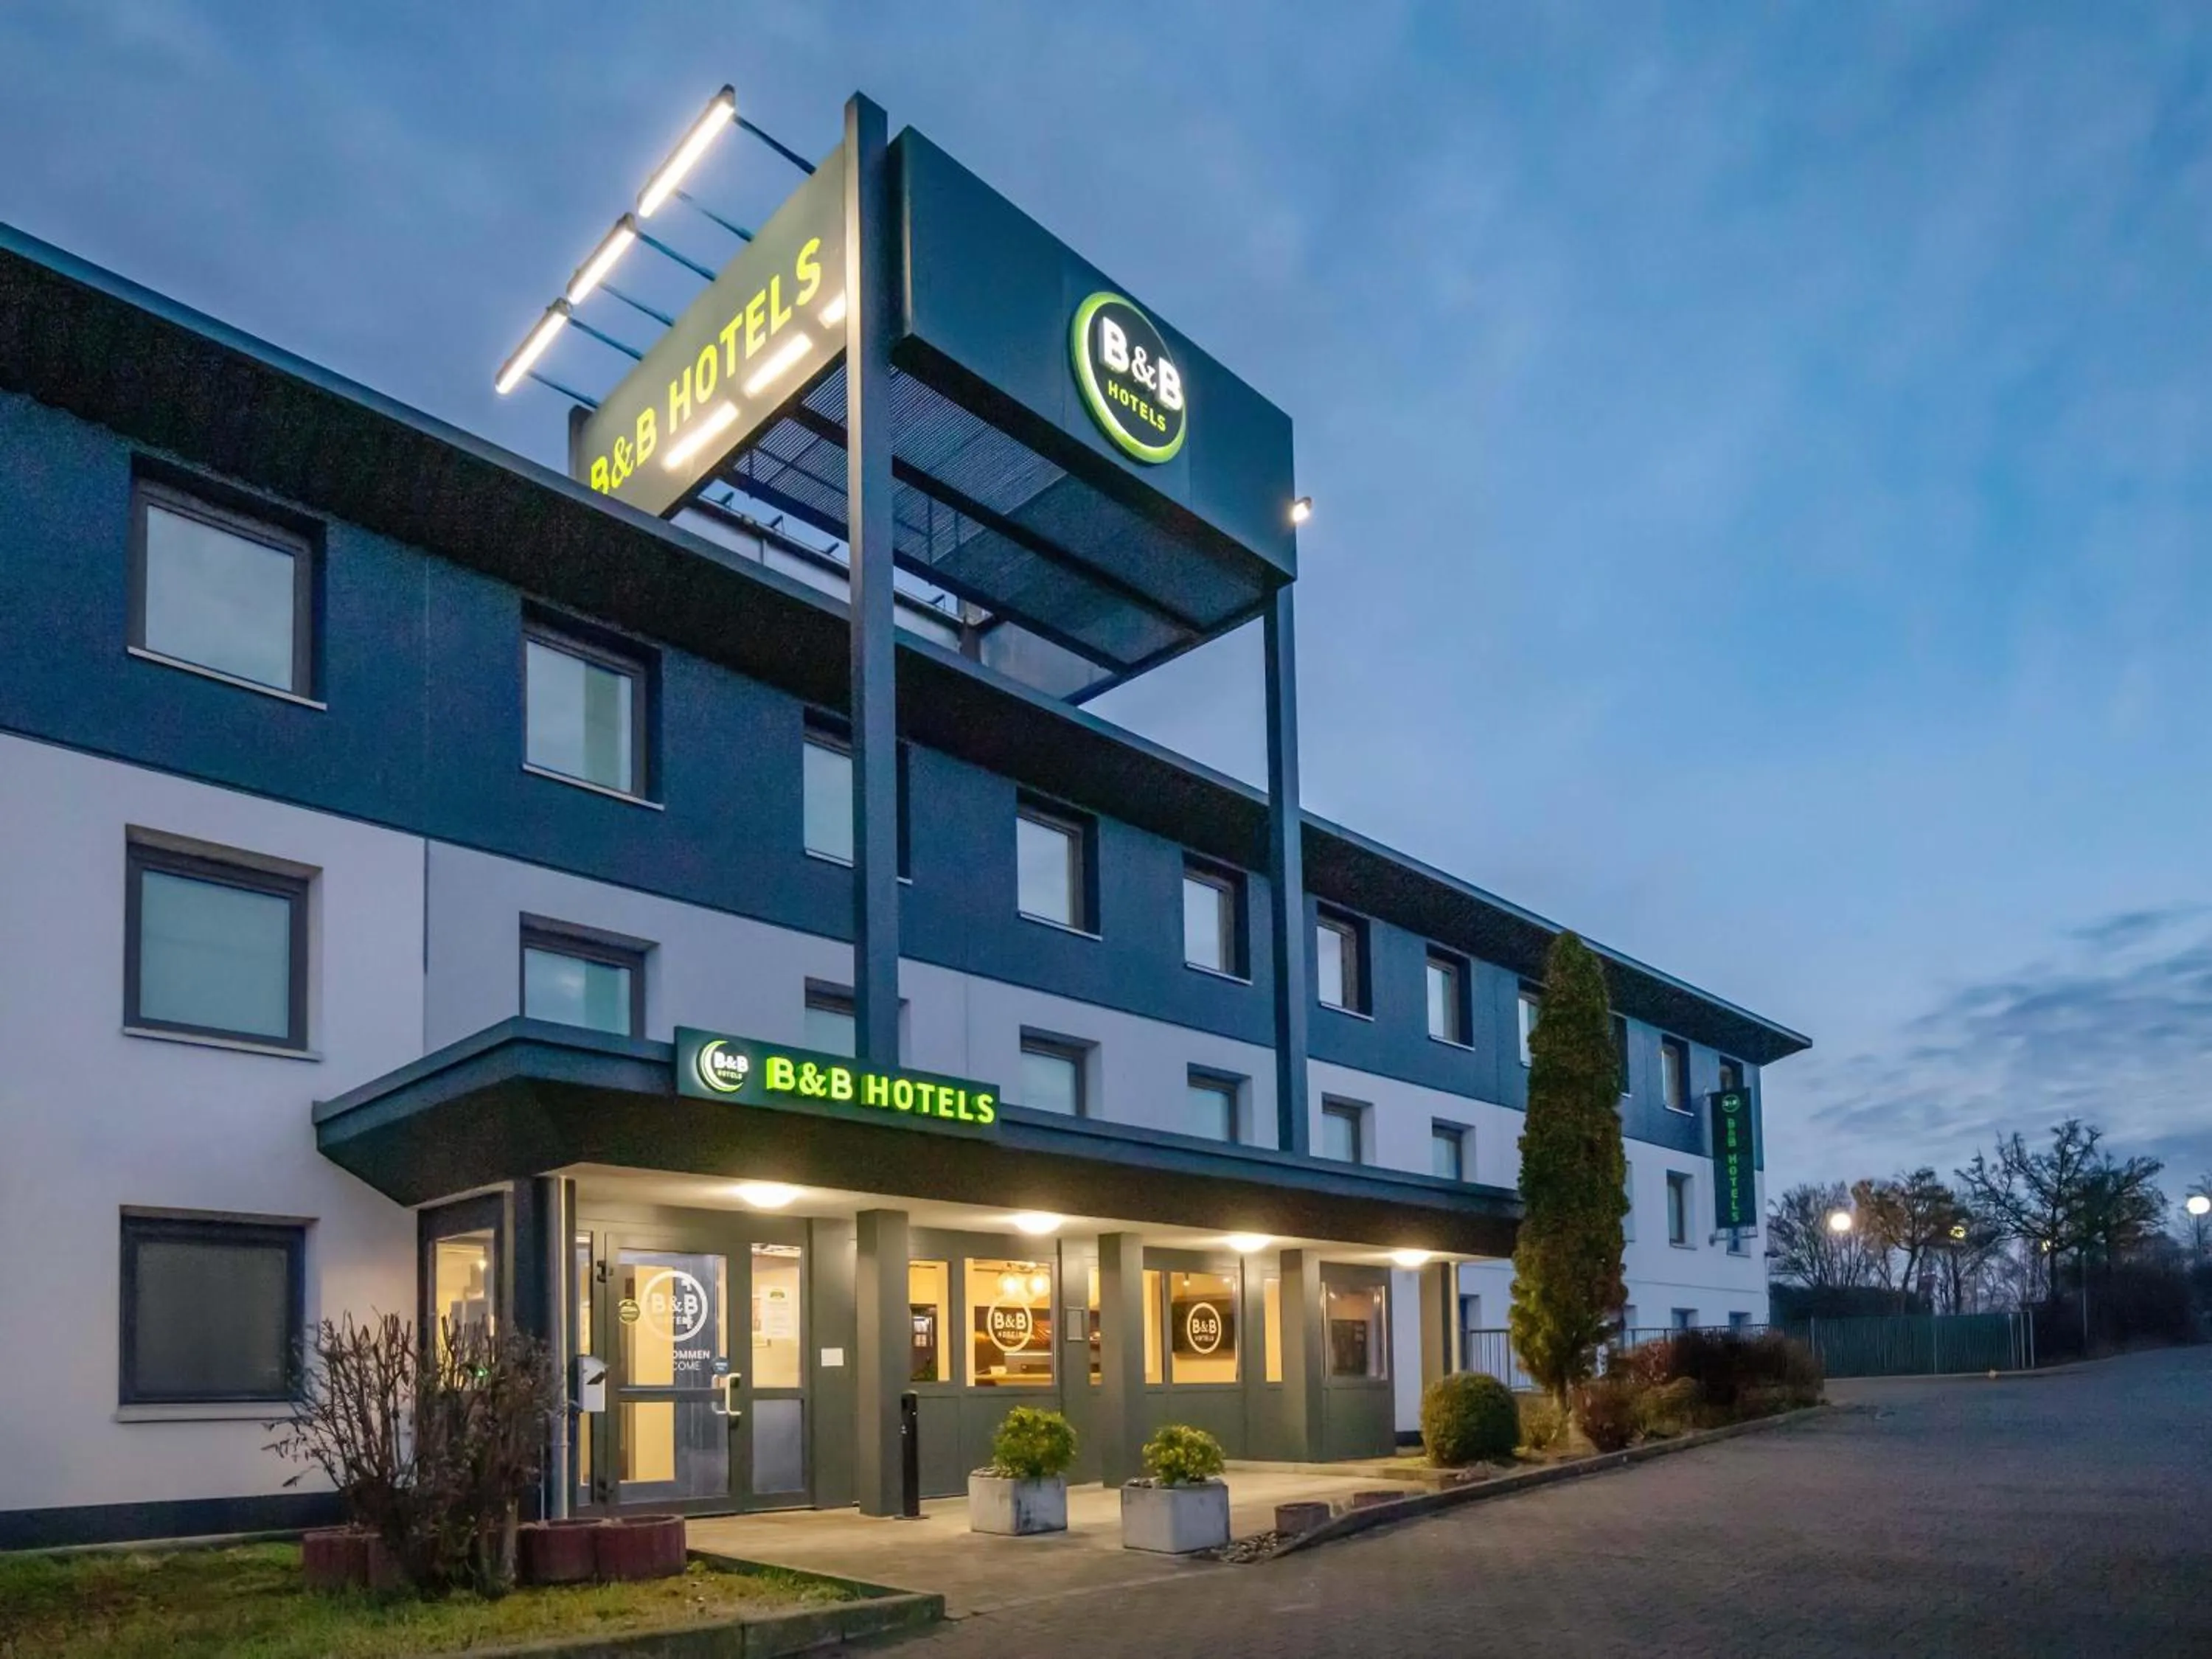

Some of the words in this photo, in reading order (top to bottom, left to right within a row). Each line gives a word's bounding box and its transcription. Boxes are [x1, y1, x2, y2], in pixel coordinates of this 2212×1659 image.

[591, 406, 658, 495] B&B
[668, 237, 821, 436] HOTELS
[1099, 316, 1184, 411] B&B
[1107, 380, 1166, 433] HOTELS
[714, 1051, 748, 1073] B&B
[766, 1056, 854, 1101] B&B
[861, 1074, 995, 1124] HOTELS
[1728, 1153, 1739, 1222] HOTELS
[651, 1293, 698, 1314] B&B
[994, 1312, 1027, 1329] B&B
[1192, 1318, 1217, 1334] B&B
